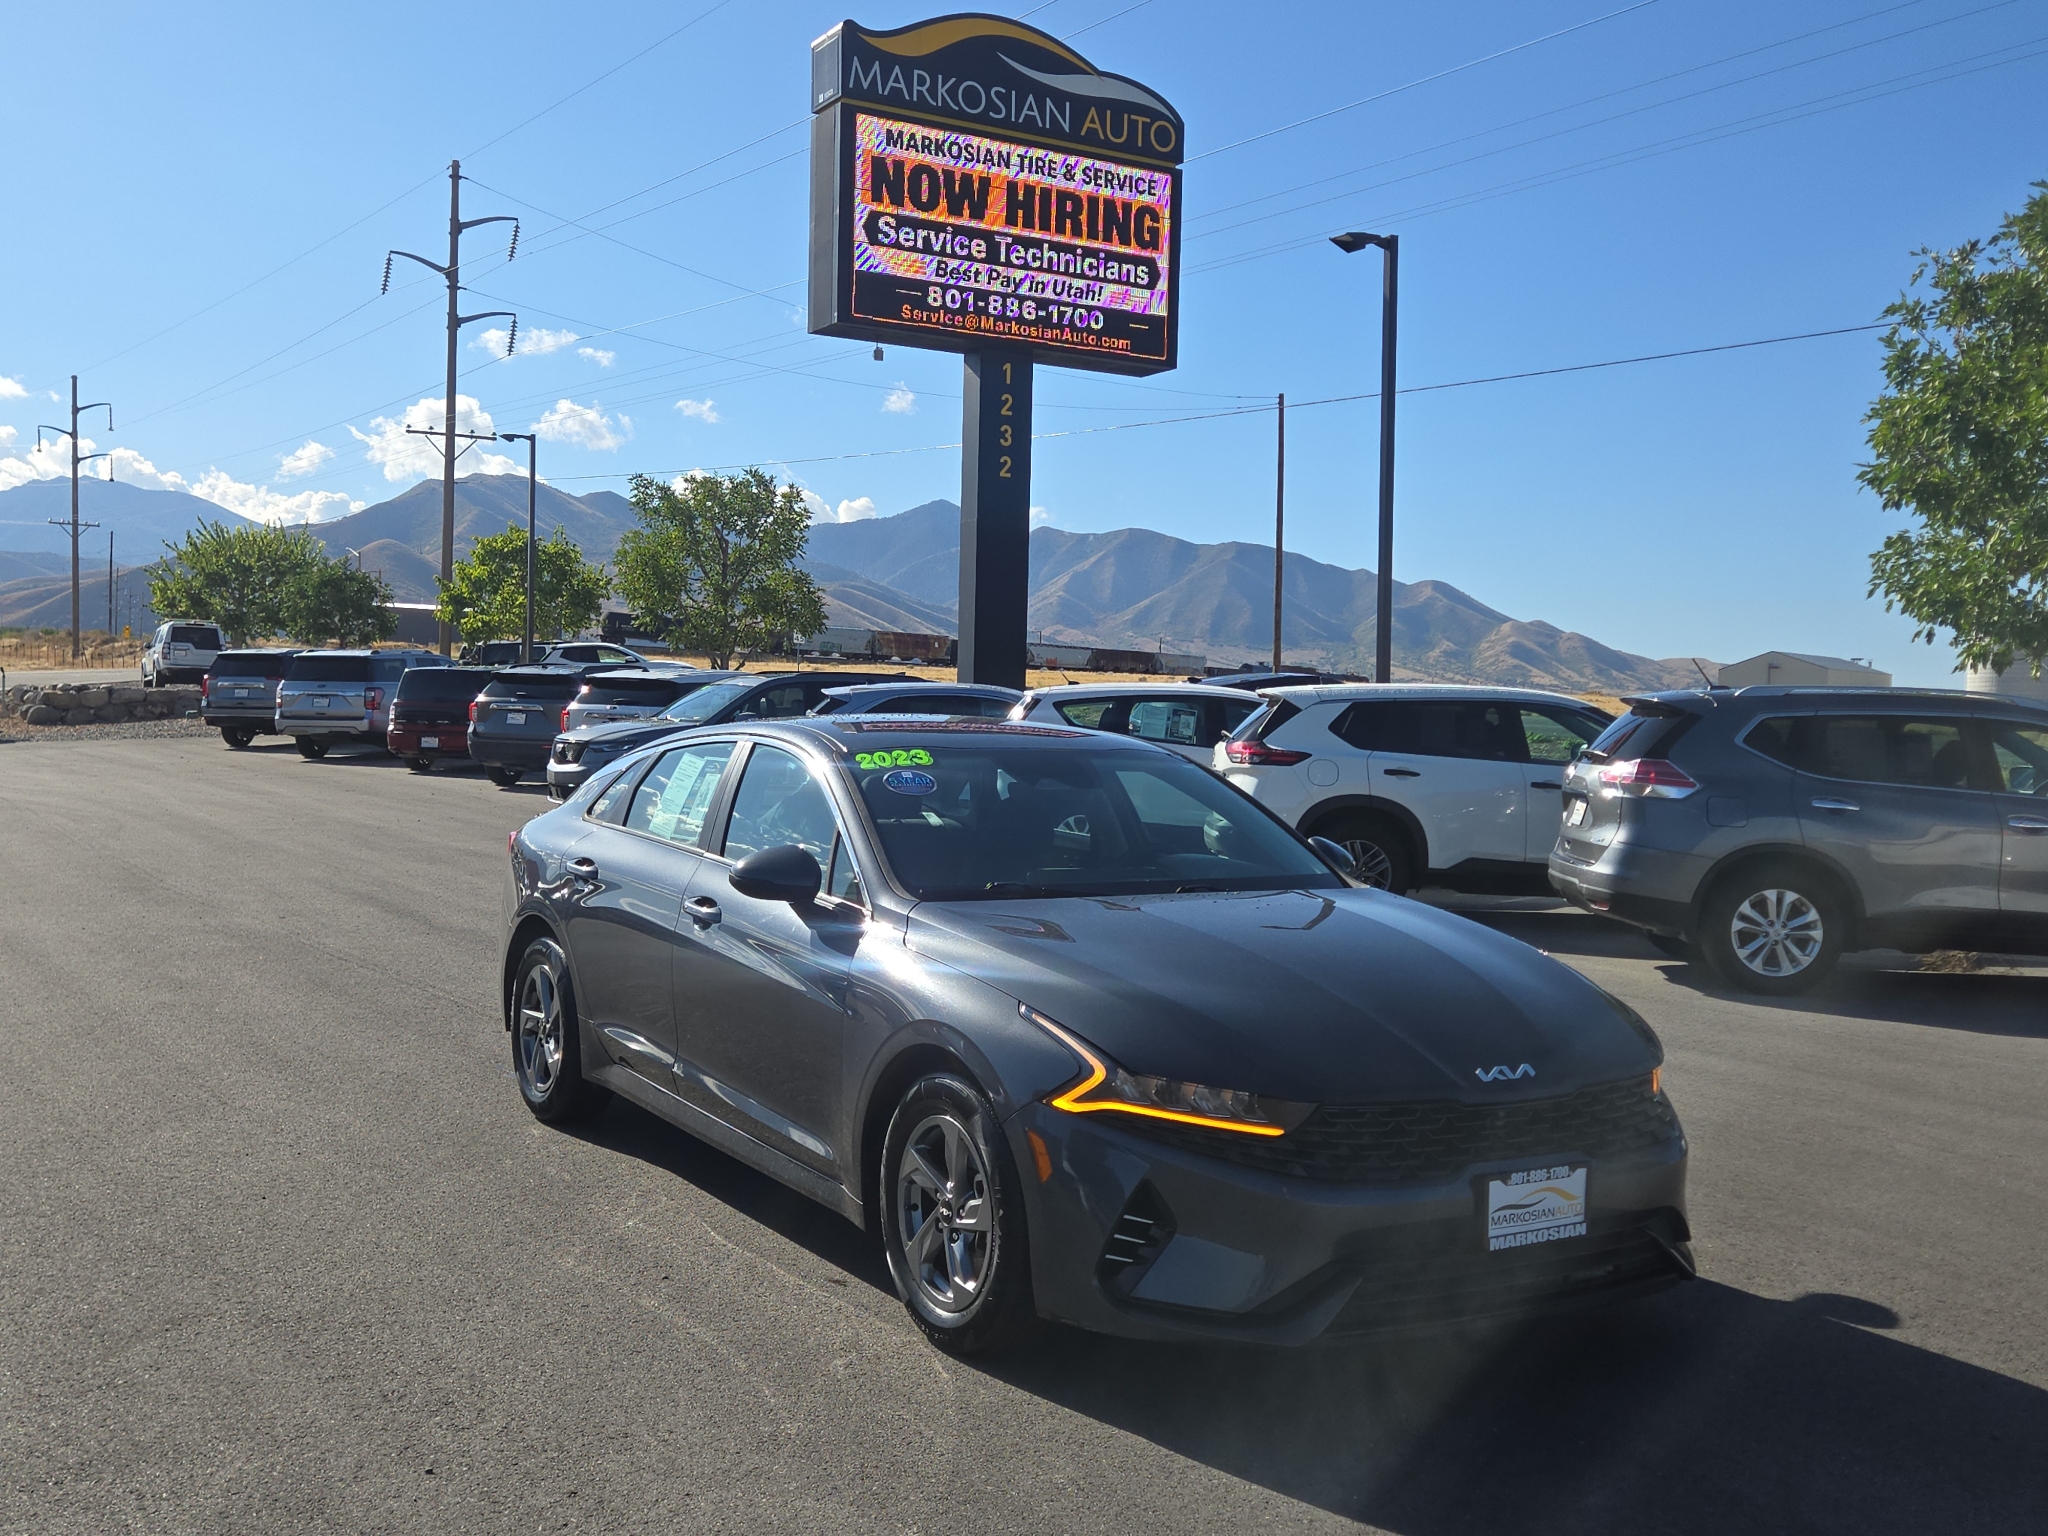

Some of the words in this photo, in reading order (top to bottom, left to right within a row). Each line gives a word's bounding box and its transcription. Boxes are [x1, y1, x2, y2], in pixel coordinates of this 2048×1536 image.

[849, 56, 1070, 133] MARKOSIAN
[1080, 106, 1176, 153] AUTO
[885, 129, 1011, 169] MARKOSIAN
[1017, 153, 1058, 179] TIRE
[1064, 163, 1076, 182] &
[1082, 165, 1157, 197] SERVICE
[871, 155, 991, 219] NOW
[1005, 181, 1160, 250] HIRING
[877, 215, 987, 259] Service
[994, 234, 1149, 286] Technicians
[935, 259, 982, 284] Best
[986, 270, 1023, 294] Pay
[1028, 275, 1046, 293] in
[1052, 278, 1103, 302] Utah!
[901, 304, 1131, 350] Service@MarkosianAuto.com
[927, 286, 1104, 330] 801-886-1700
[855, 749, 934, 770] 2023
[899, 777, 931, 785] YEAR
[1475, 1063, 1536, 1082] KIA
[1510, 1165, 1570, 1185] 801-886-1700
[1489, 1222, 1587, 1252] MARKOSIAN
